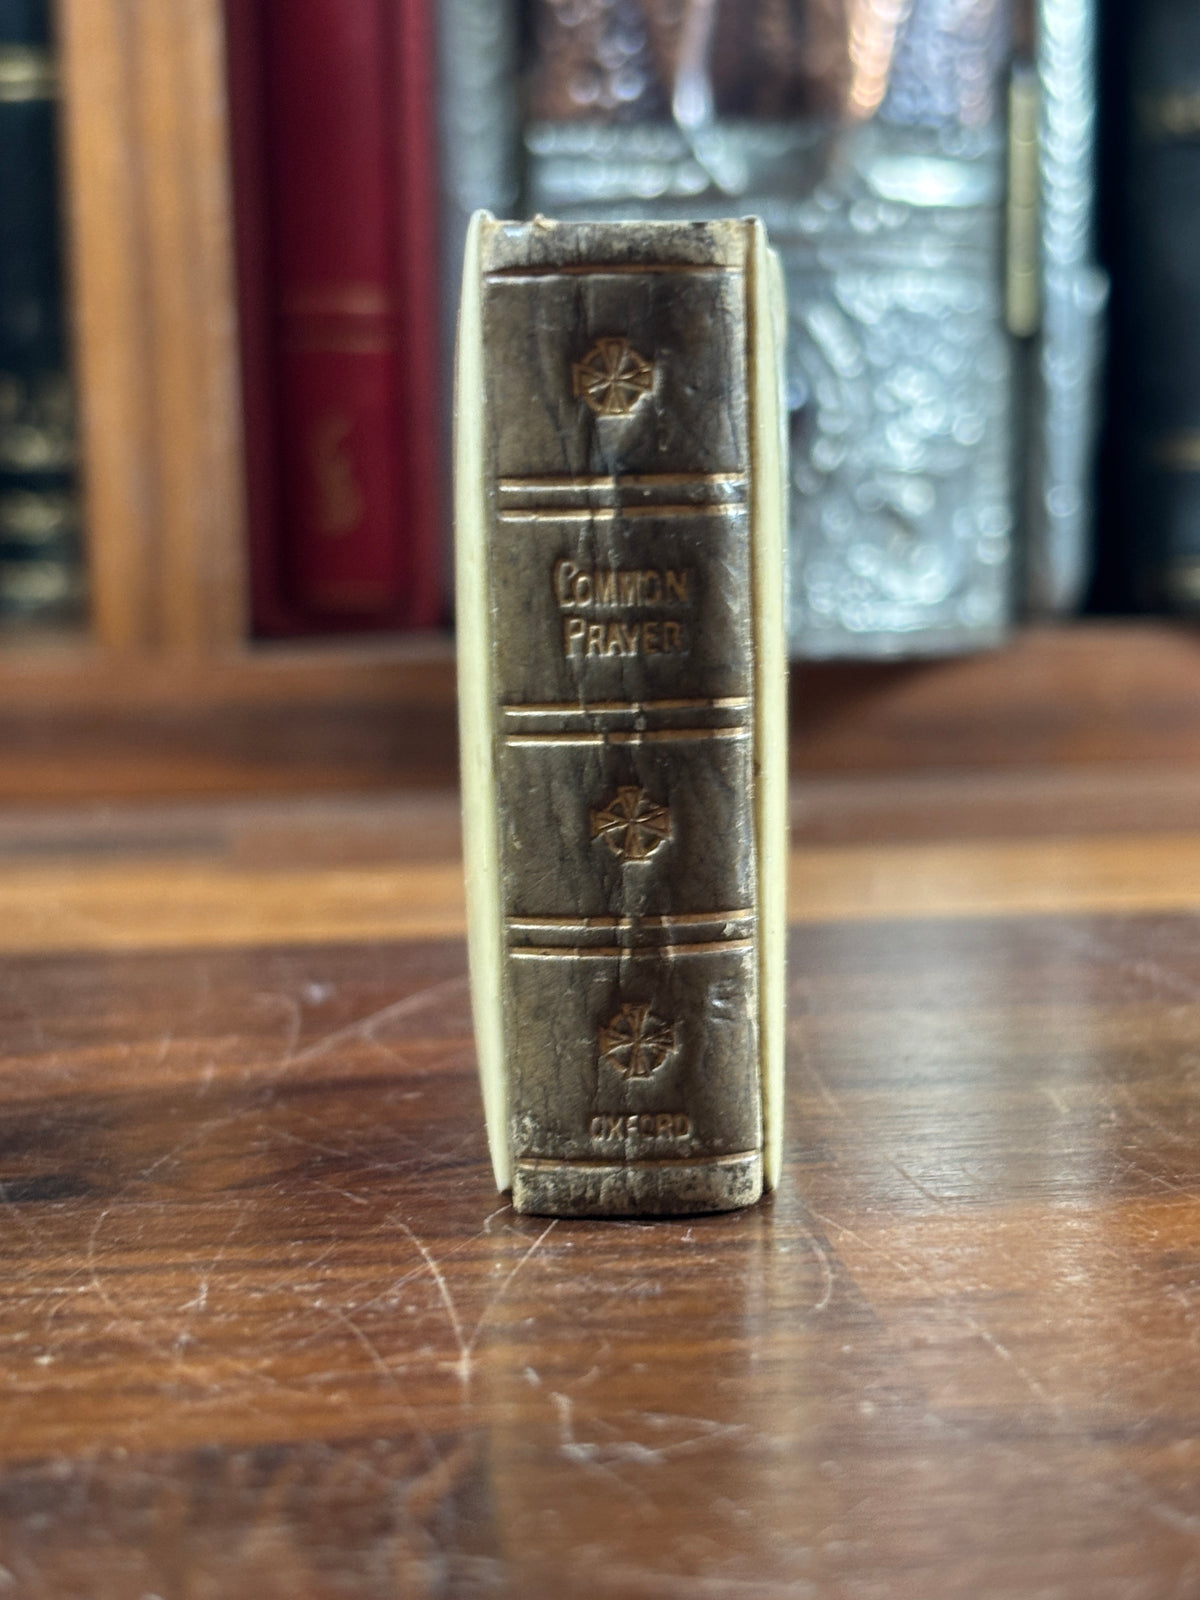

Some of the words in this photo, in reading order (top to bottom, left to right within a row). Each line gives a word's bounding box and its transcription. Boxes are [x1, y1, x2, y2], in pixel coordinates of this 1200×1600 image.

[554, 558, 691, 607] COMMON
[563, 616, 690, 658] PRAYER
[590, 1113, 693, 1142] OXFORD
